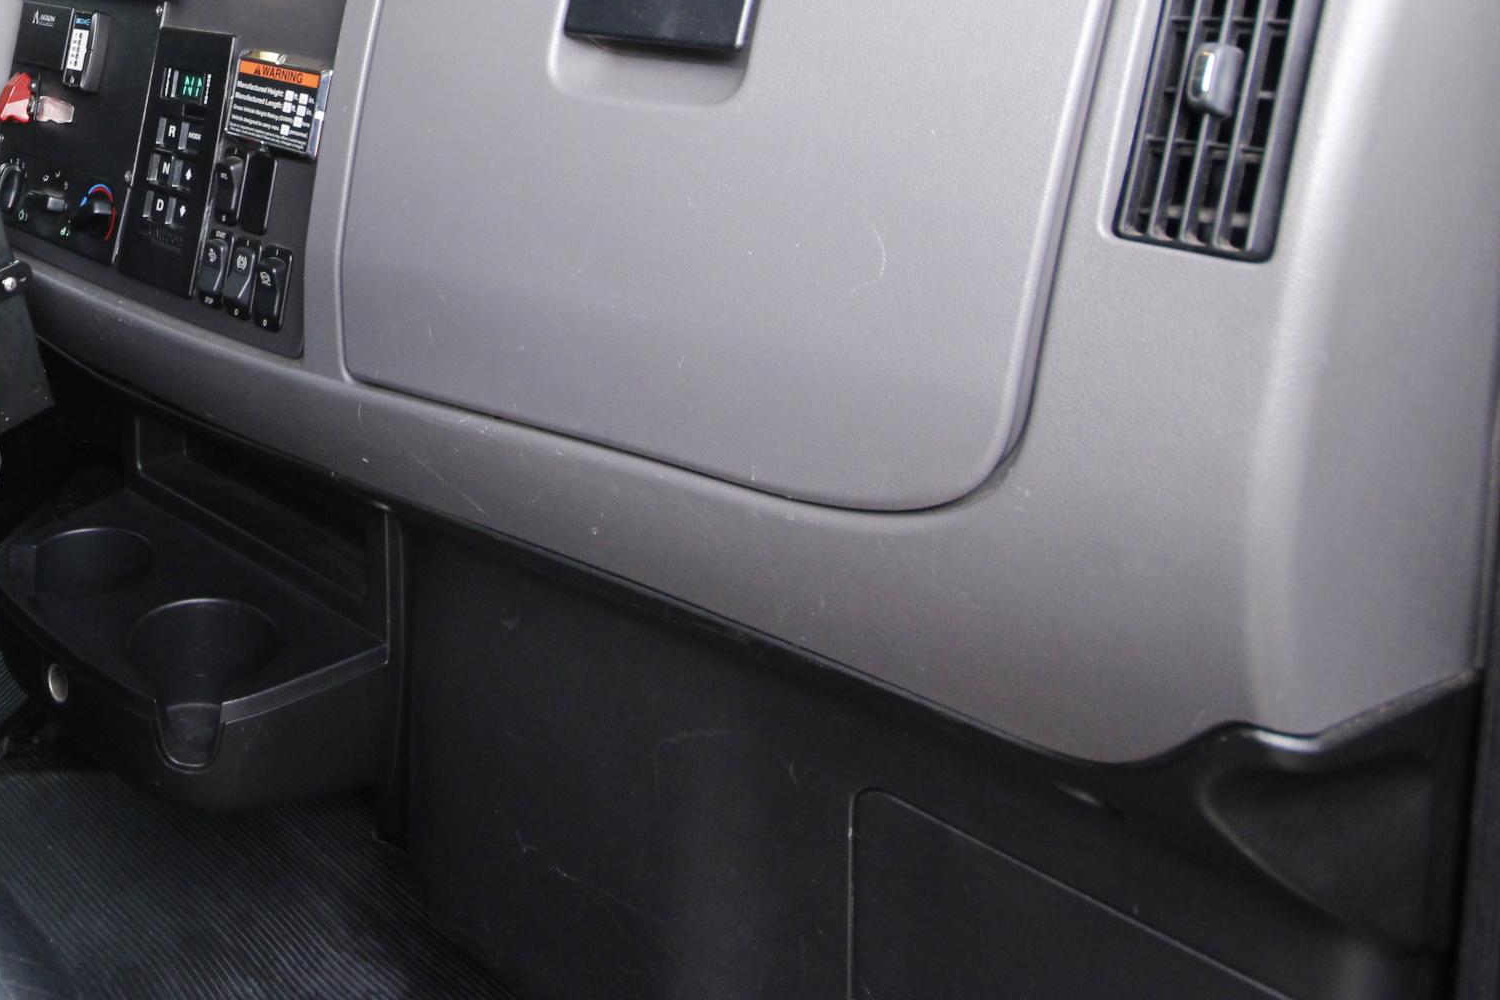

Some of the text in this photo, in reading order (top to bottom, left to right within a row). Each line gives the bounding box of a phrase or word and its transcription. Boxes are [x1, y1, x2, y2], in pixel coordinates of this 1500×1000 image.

[262, 64, 304, 84] WARNING
[168, 124, 176, 138] R
[162, 161, 170, 175] N
[156, 198, 164, 212] D
